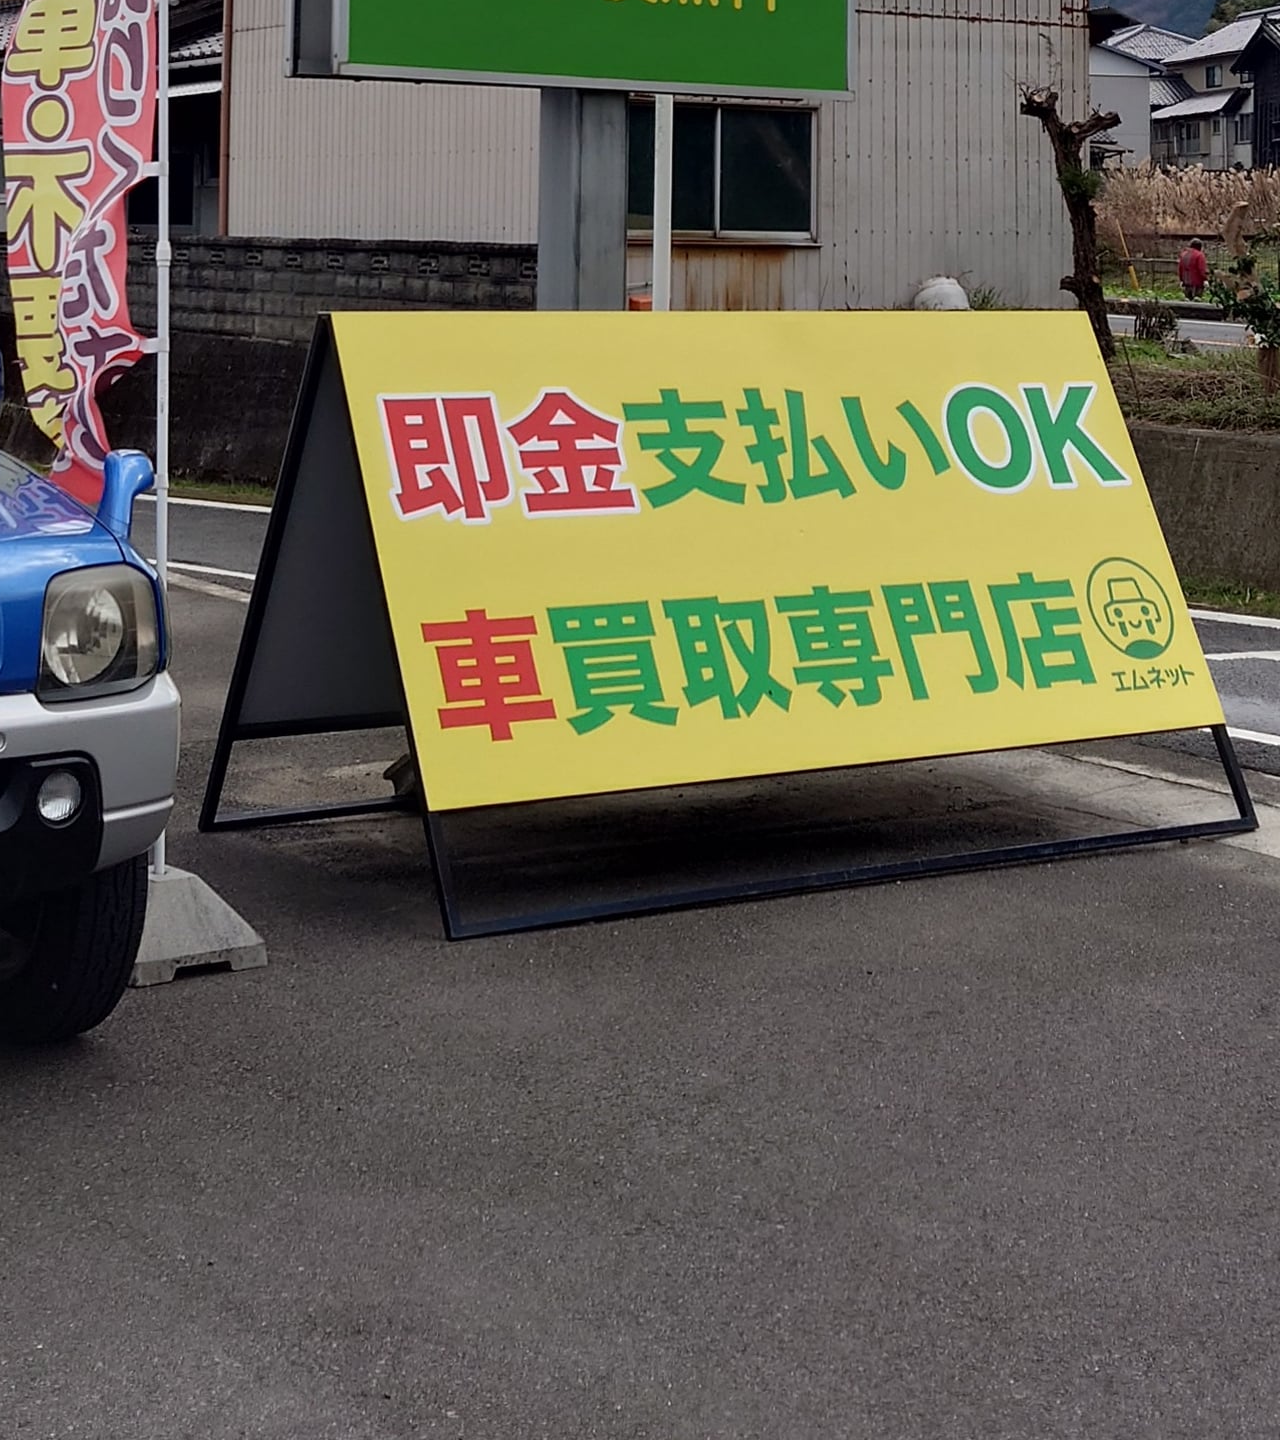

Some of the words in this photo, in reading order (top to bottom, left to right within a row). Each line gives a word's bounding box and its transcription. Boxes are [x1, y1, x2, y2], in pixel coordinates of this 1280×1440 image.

[378, 382, 1129, 523] 即金支払いOK
[420, 570, 1096, 742] 車買取専門店
[1110, 663, 1196, 692] エムネット
